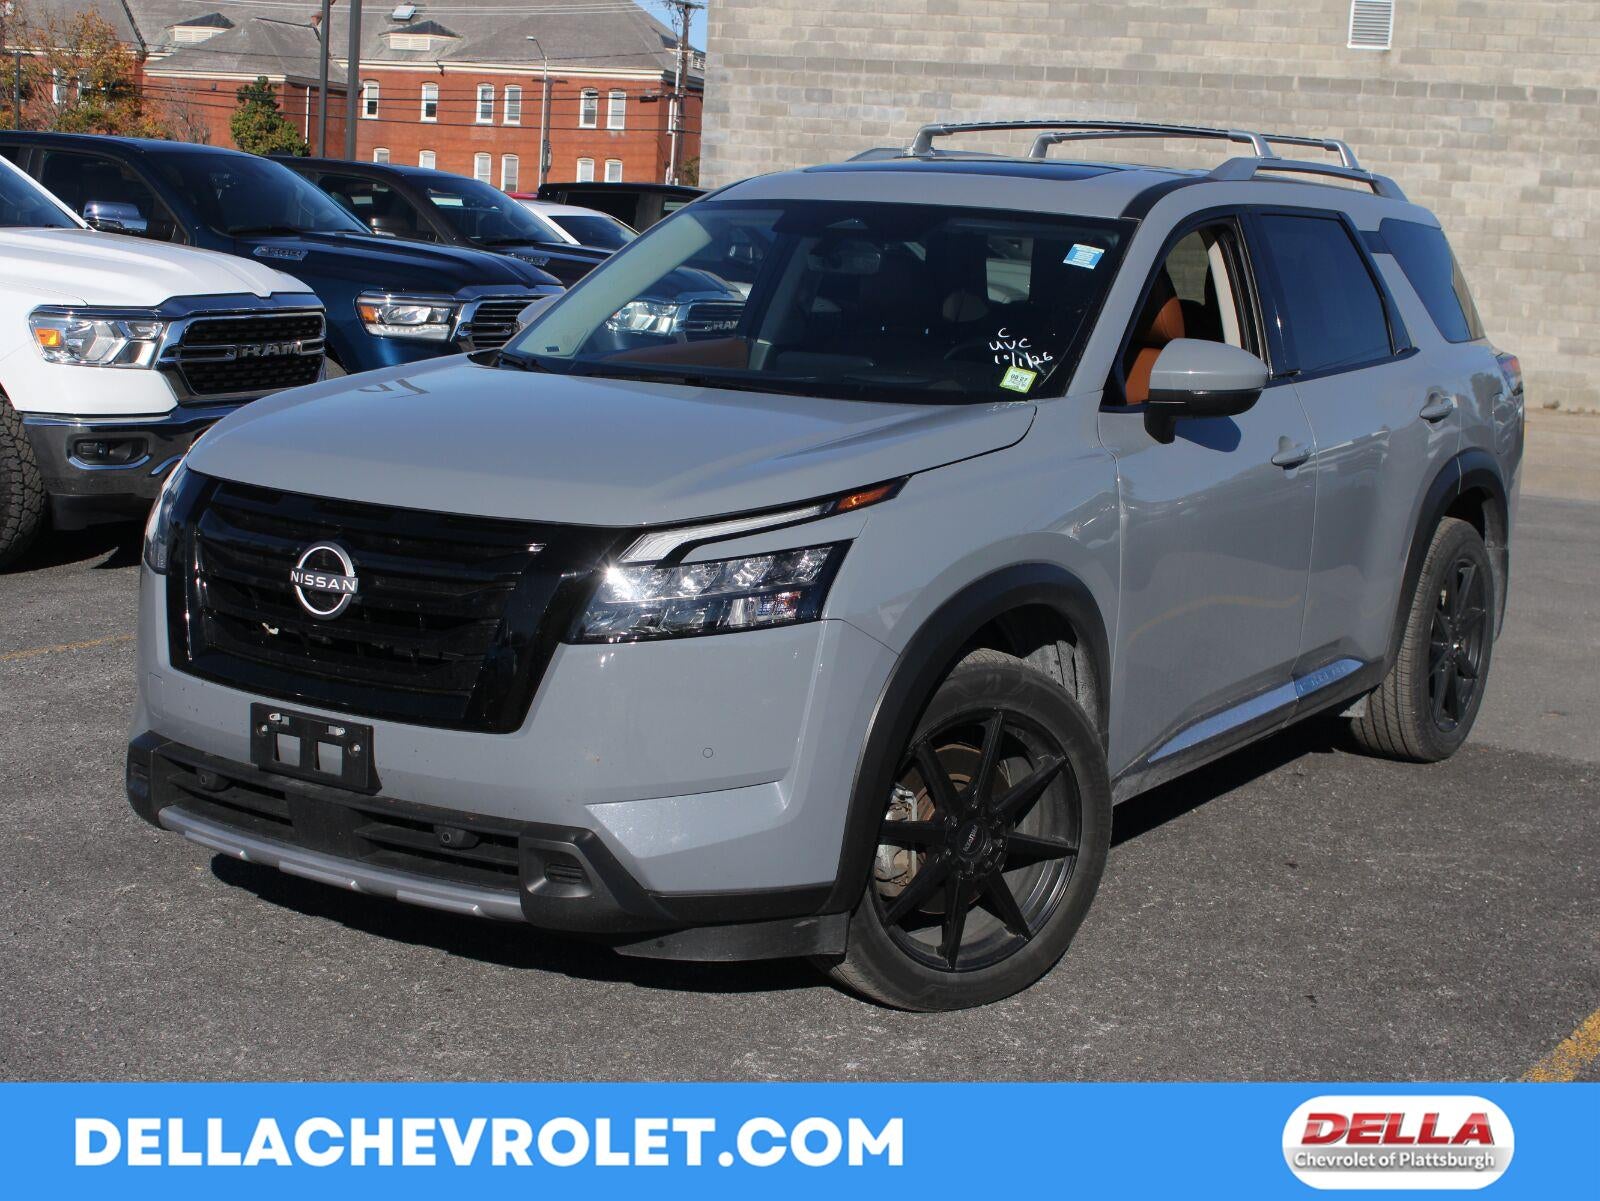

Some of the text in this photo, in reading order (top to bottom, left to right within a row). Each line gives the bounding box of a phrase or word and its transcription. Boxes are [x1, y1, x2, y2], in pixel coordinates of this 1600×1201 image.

[998, 328, 1011, 338] C
[241, 341, 302, 358] RAM
[989, 338, 1032, 351] UVC
[291, 570, 356, 592] NISSAN
